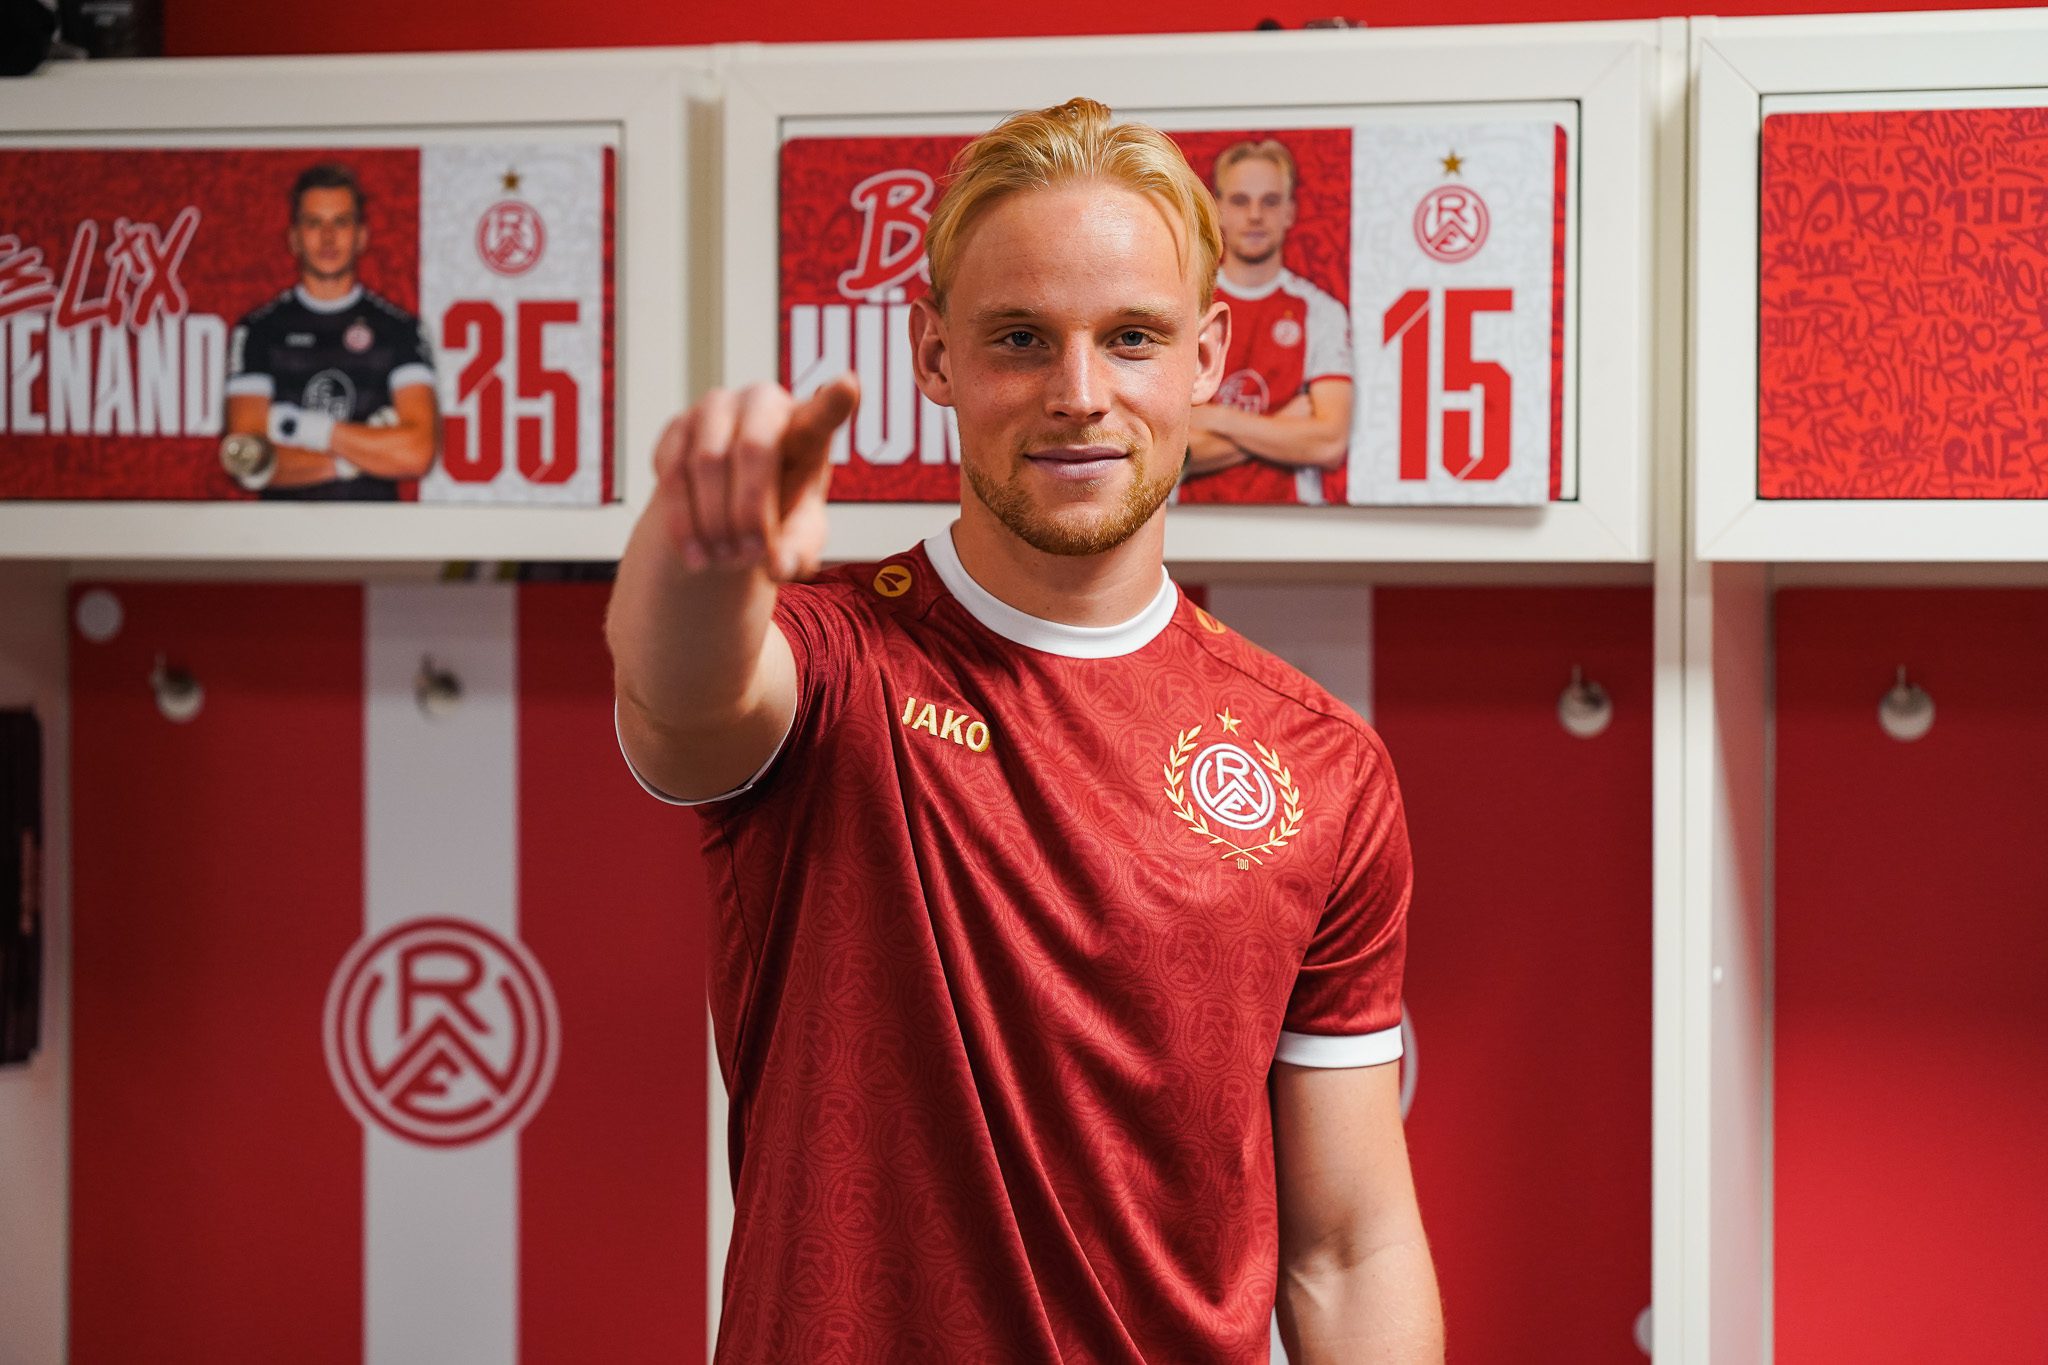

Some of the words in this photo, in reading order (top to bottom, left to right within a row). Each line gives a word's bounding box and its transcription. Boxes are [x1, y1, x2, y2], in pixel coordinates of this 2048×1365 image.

[838, 168, 933, 298] B
[442, 299, 579, 484] 35
[1383, 288, 1513, 481] 15
[902, 696, 990, 753] JAKO
[1236, 858, 1249, 870] 100
